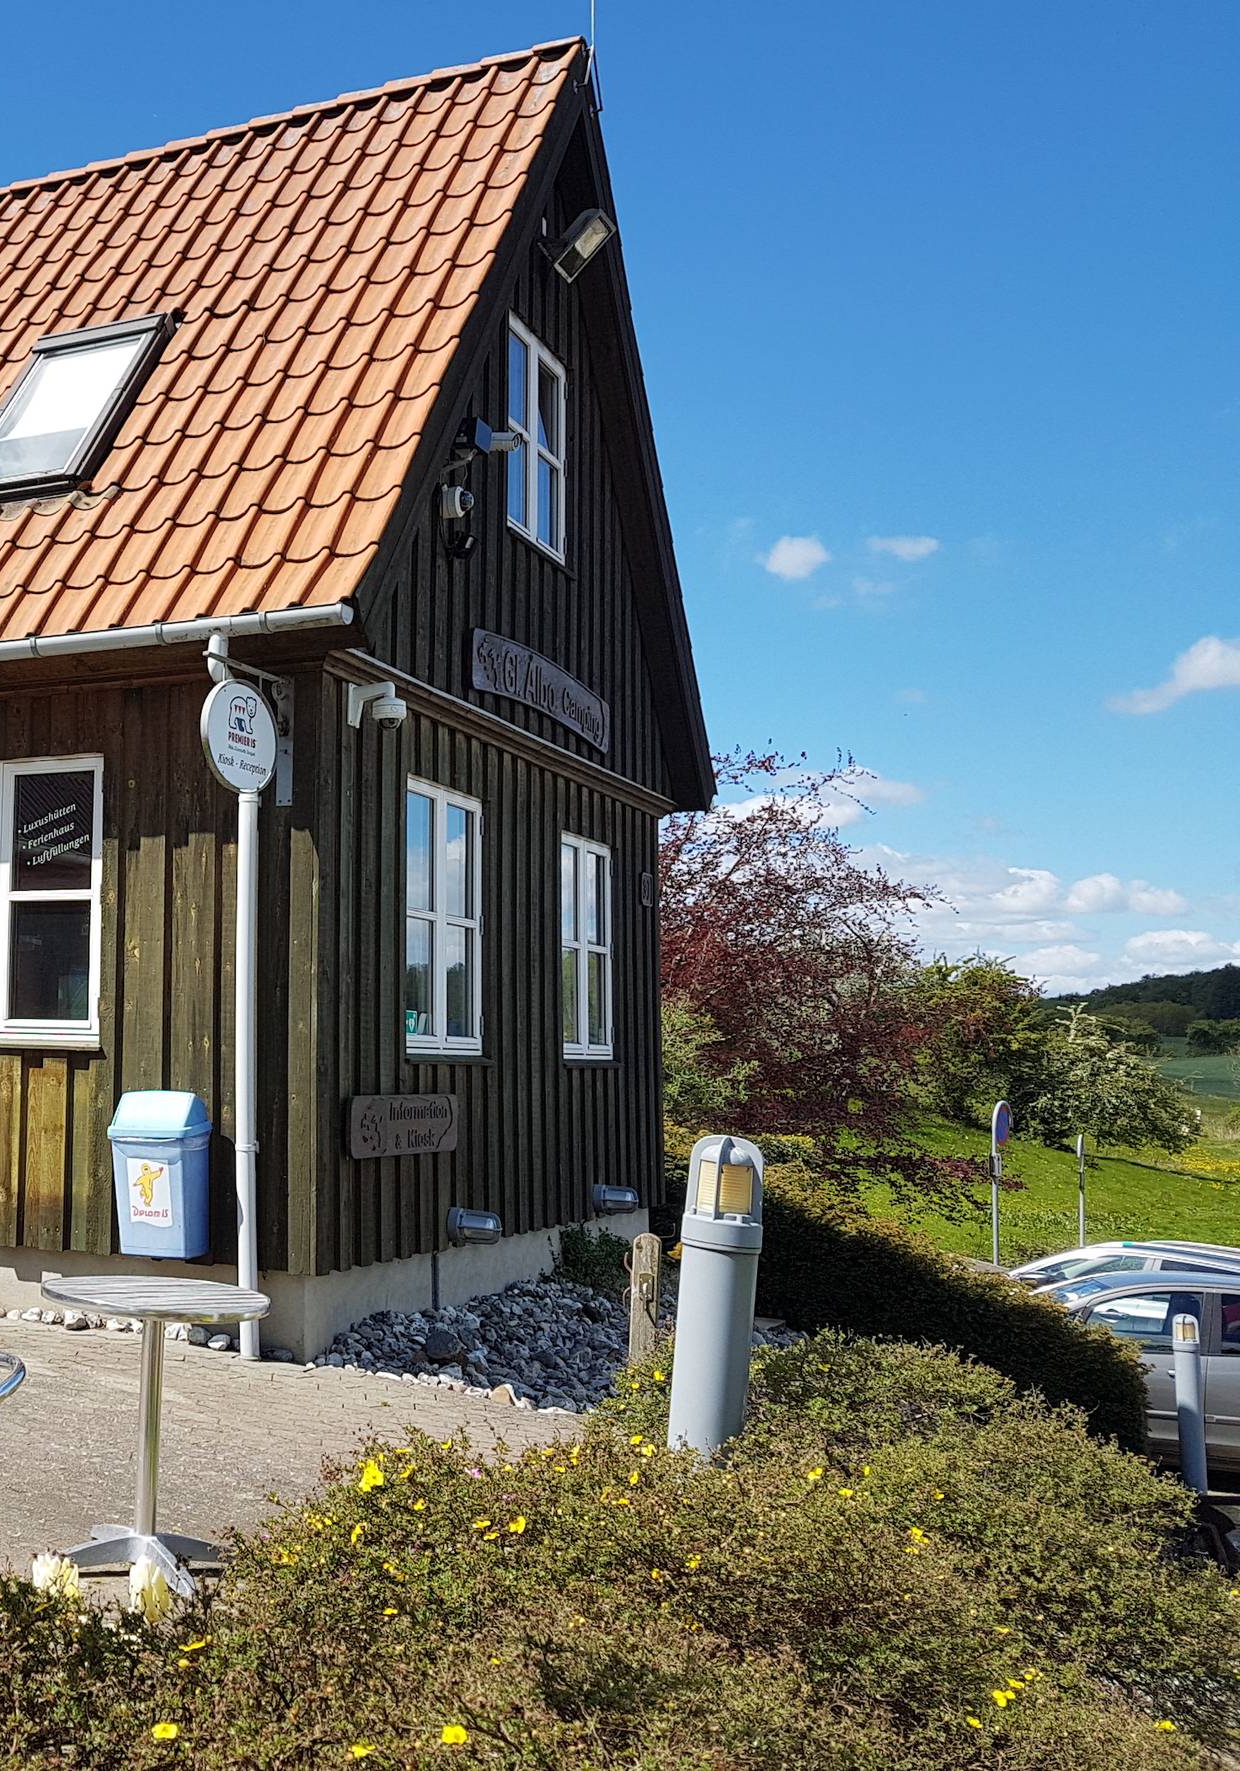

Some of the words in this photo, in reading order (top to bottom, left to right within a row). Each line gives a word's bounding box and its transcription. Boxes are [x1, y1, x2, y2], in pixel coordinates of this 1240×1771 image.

[562, 687, 600, 742] Camping
[217, 753, 234, 767] Kiosk
[239, 759, 267, 776] Reception
[23, 803, 77, 834] Luxushütten
[27, 822, 75, 850] Ferienhaus
[389, 1100, 448, 1121] Information
[407, 1128, 435, 1149] Kiosk
